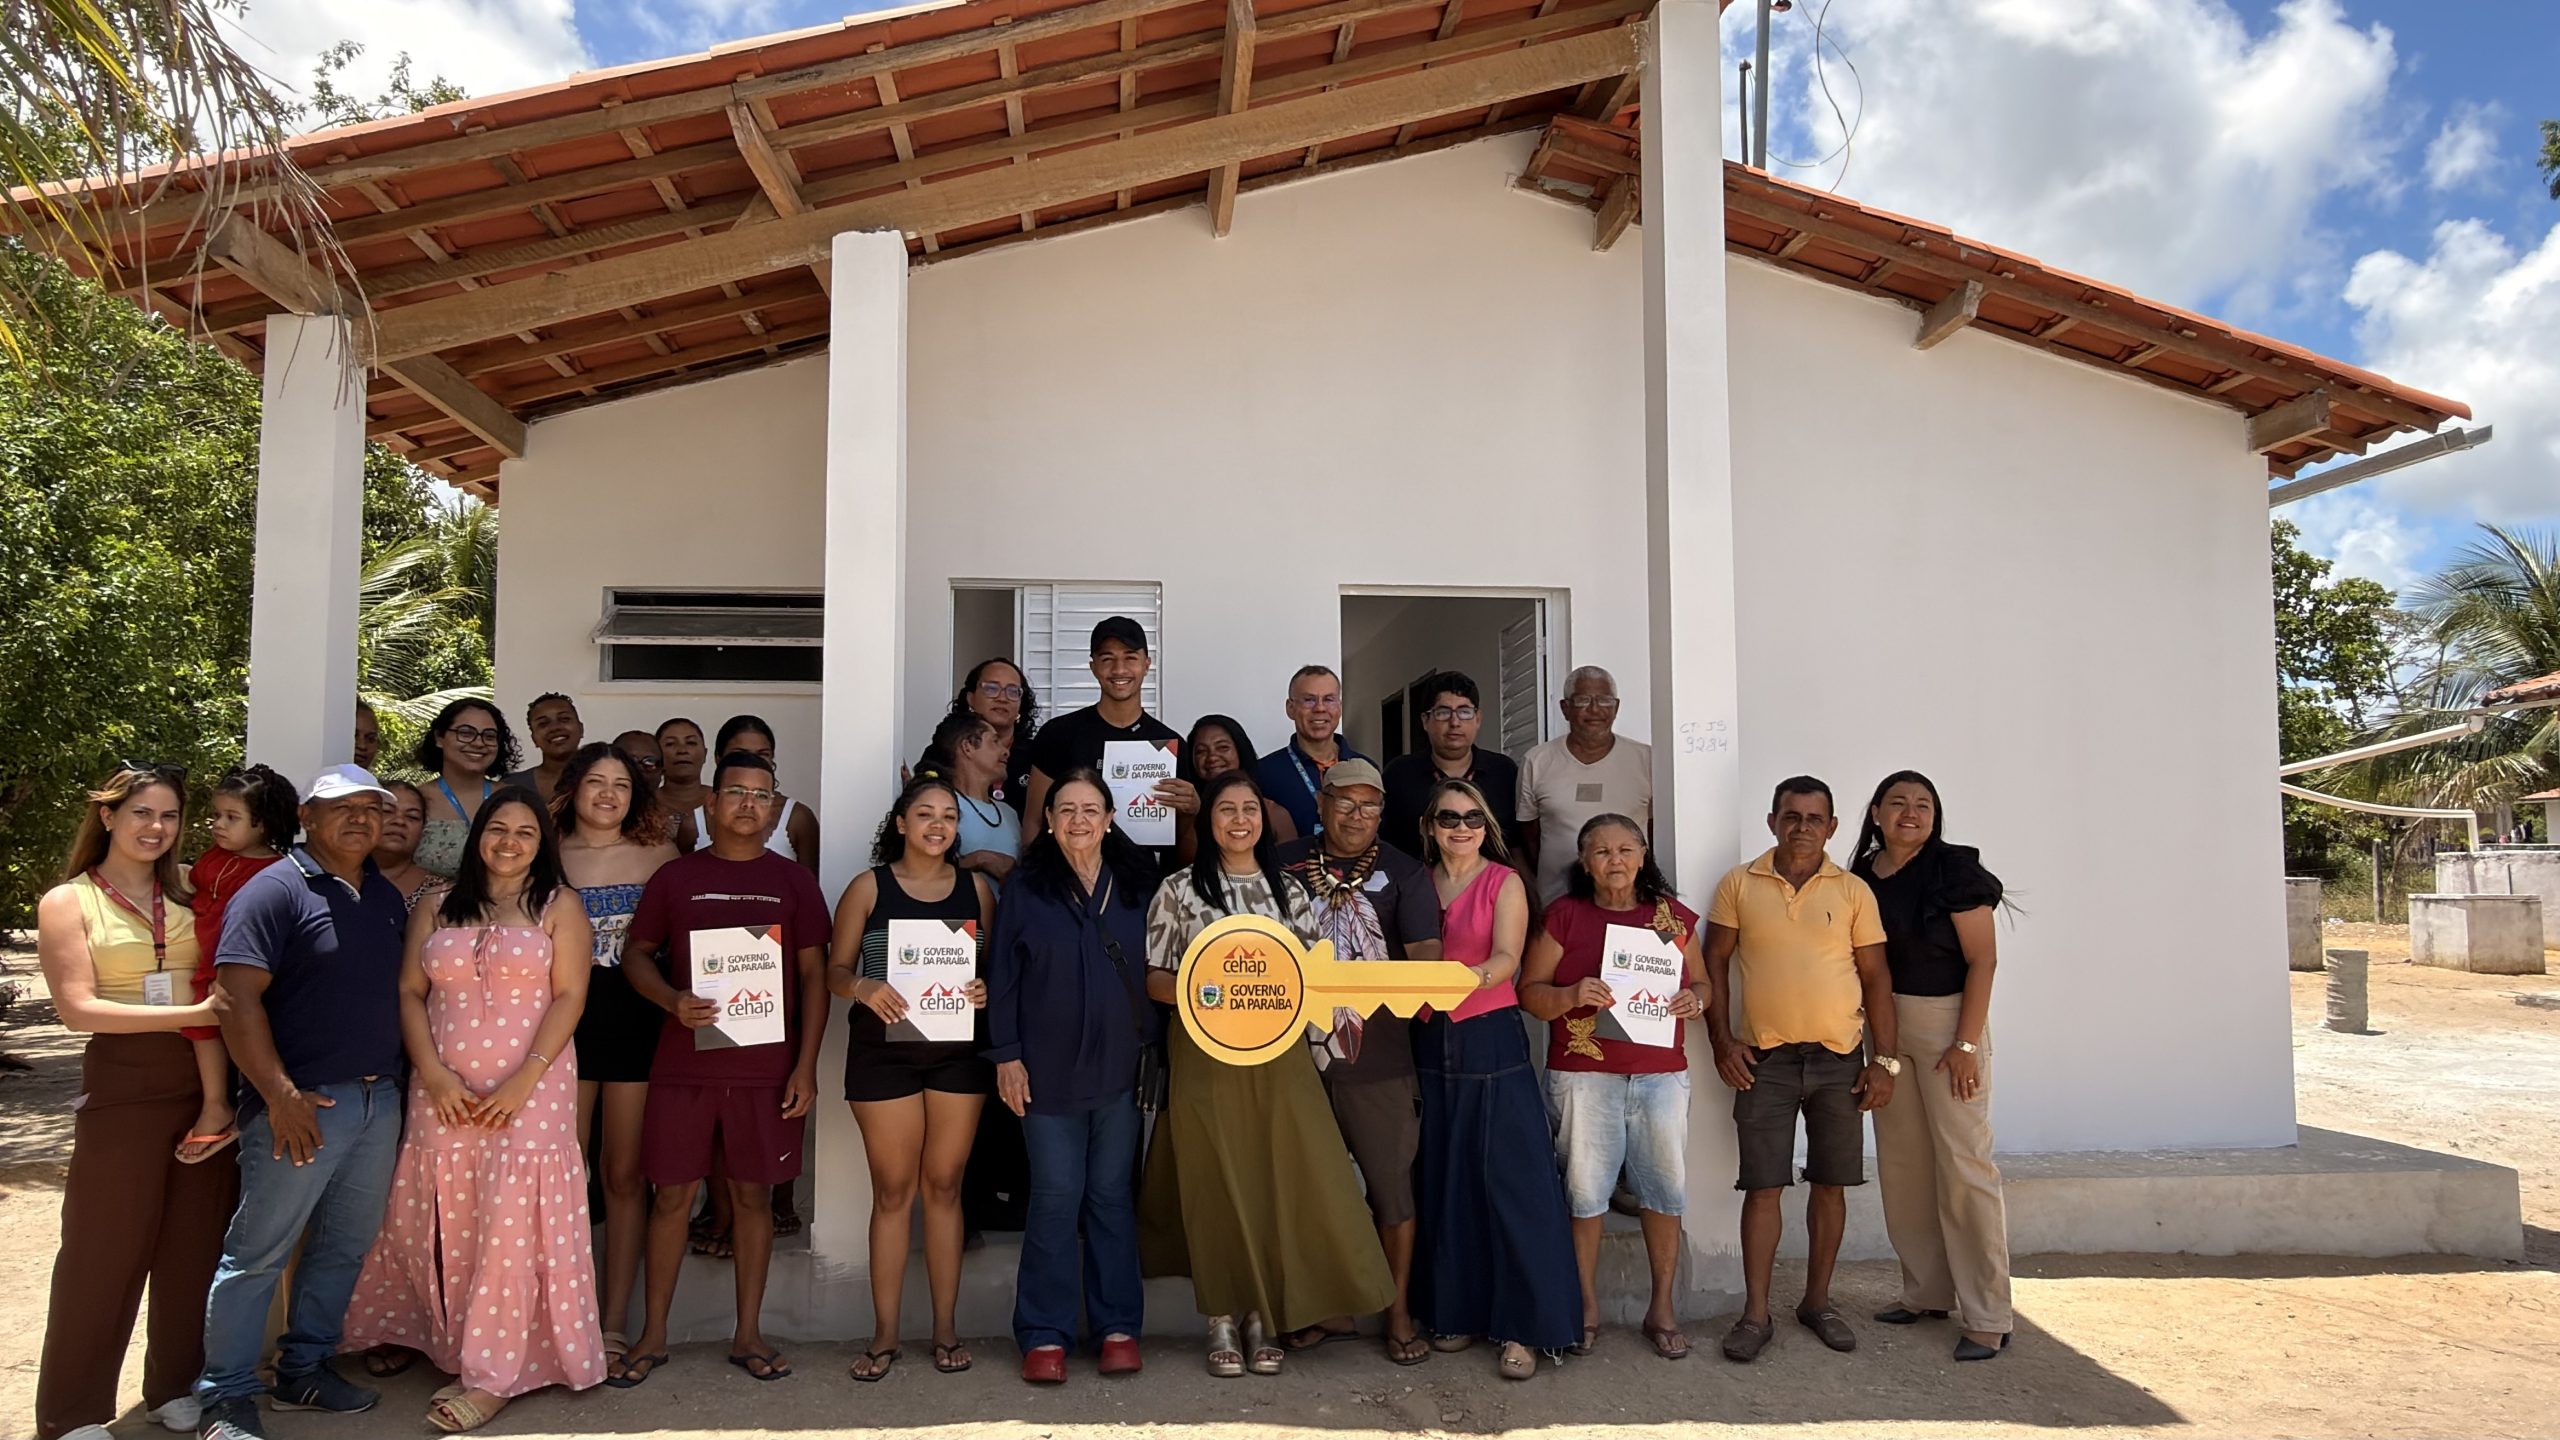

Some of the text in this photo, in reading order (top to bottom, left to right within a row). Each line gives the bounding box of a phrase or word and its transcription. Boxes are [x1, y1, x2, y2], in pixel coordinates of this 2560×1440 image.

[1132, 763, 1166, 771] GOVERNO
[1131, 771, 1141, 779] DA
[1127, 802, 1167, 822] cehap
[924, 948, 964, 956] GOVERNO
[728, 953, 769, 964] GOVERNO
[923, 957, 934, 965] DA
[1635, 954, 1672, 966] GOVERNO
[728, 964, 740, 973] DA
[1223, 955, 1266, 977] cehap
[1634, 963, 1644, 972] DA
[1230, 984, 1286, 996] GOVERNO
[727, 998, 774, 1018] cehap
[920, 993, 965, 1014] cehap
[1230, 996, 1293, 1010] DA PARAÍBA
[1627, 999, 1669, 1021] cehap
